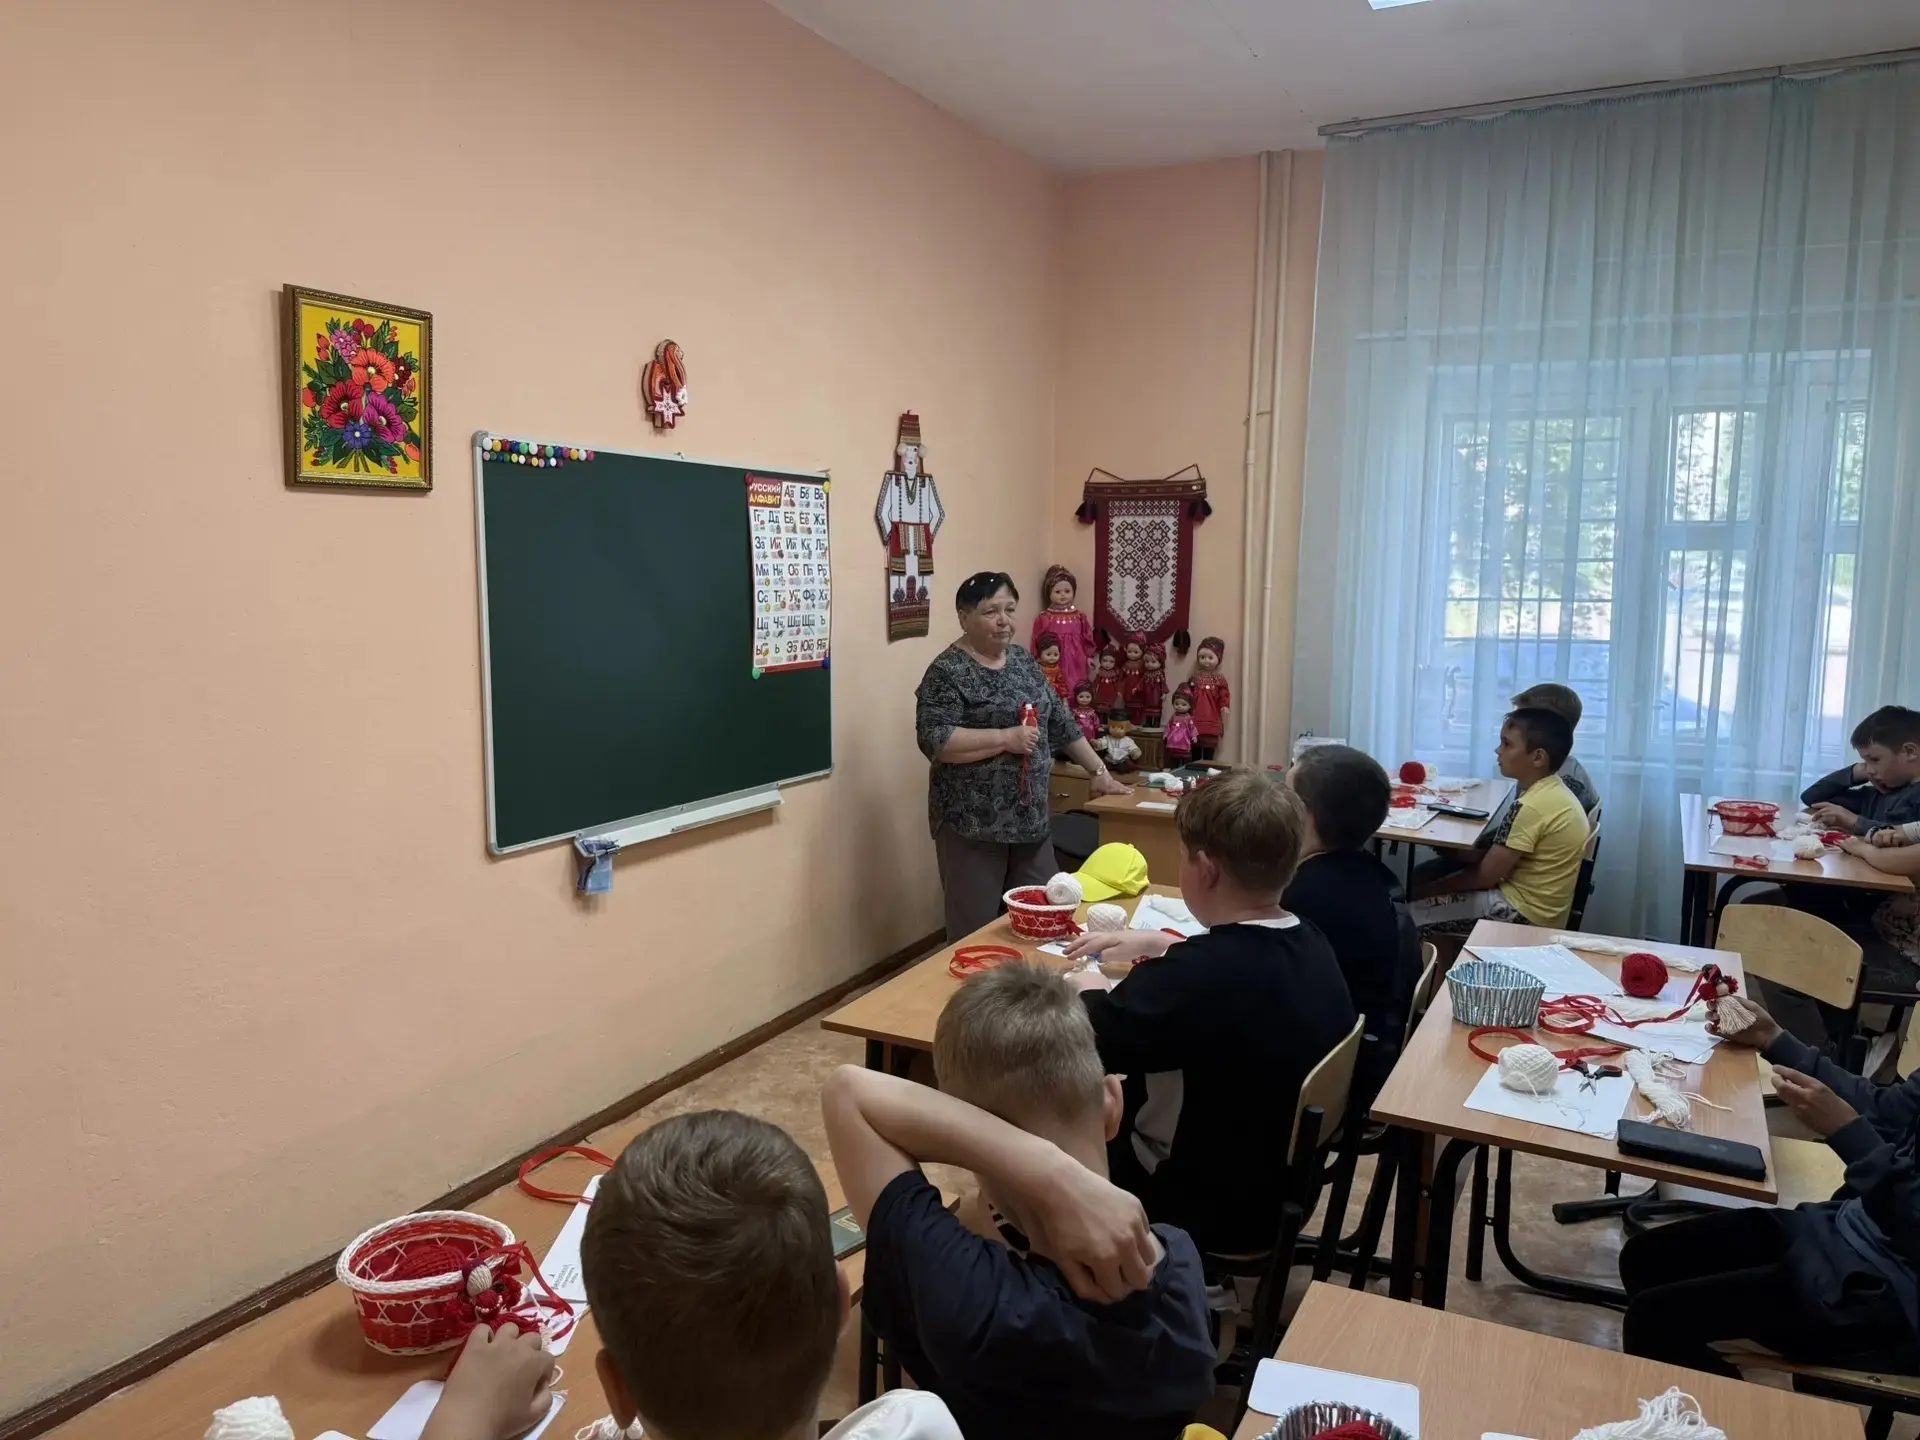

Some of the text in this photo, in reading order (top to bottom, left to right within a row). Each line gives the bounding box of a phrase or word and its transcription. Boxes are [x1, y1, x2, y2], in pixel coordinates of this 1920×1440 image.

[785, 485, 794, 498] Аа
[800, 486, 809, 499] Бб
[750, 494, 780, 504] АЛФАВИТ
[755, 536, 765, 549] Зз
[802, 538, 811, 550] Кк
[756, 563, 827, 577] Мм Нн Оо Пп Рр
[757, 590, 768, 603] Сс
[774, 590, 781, 602] Тт
[757, 617, 768, 630] Цц
